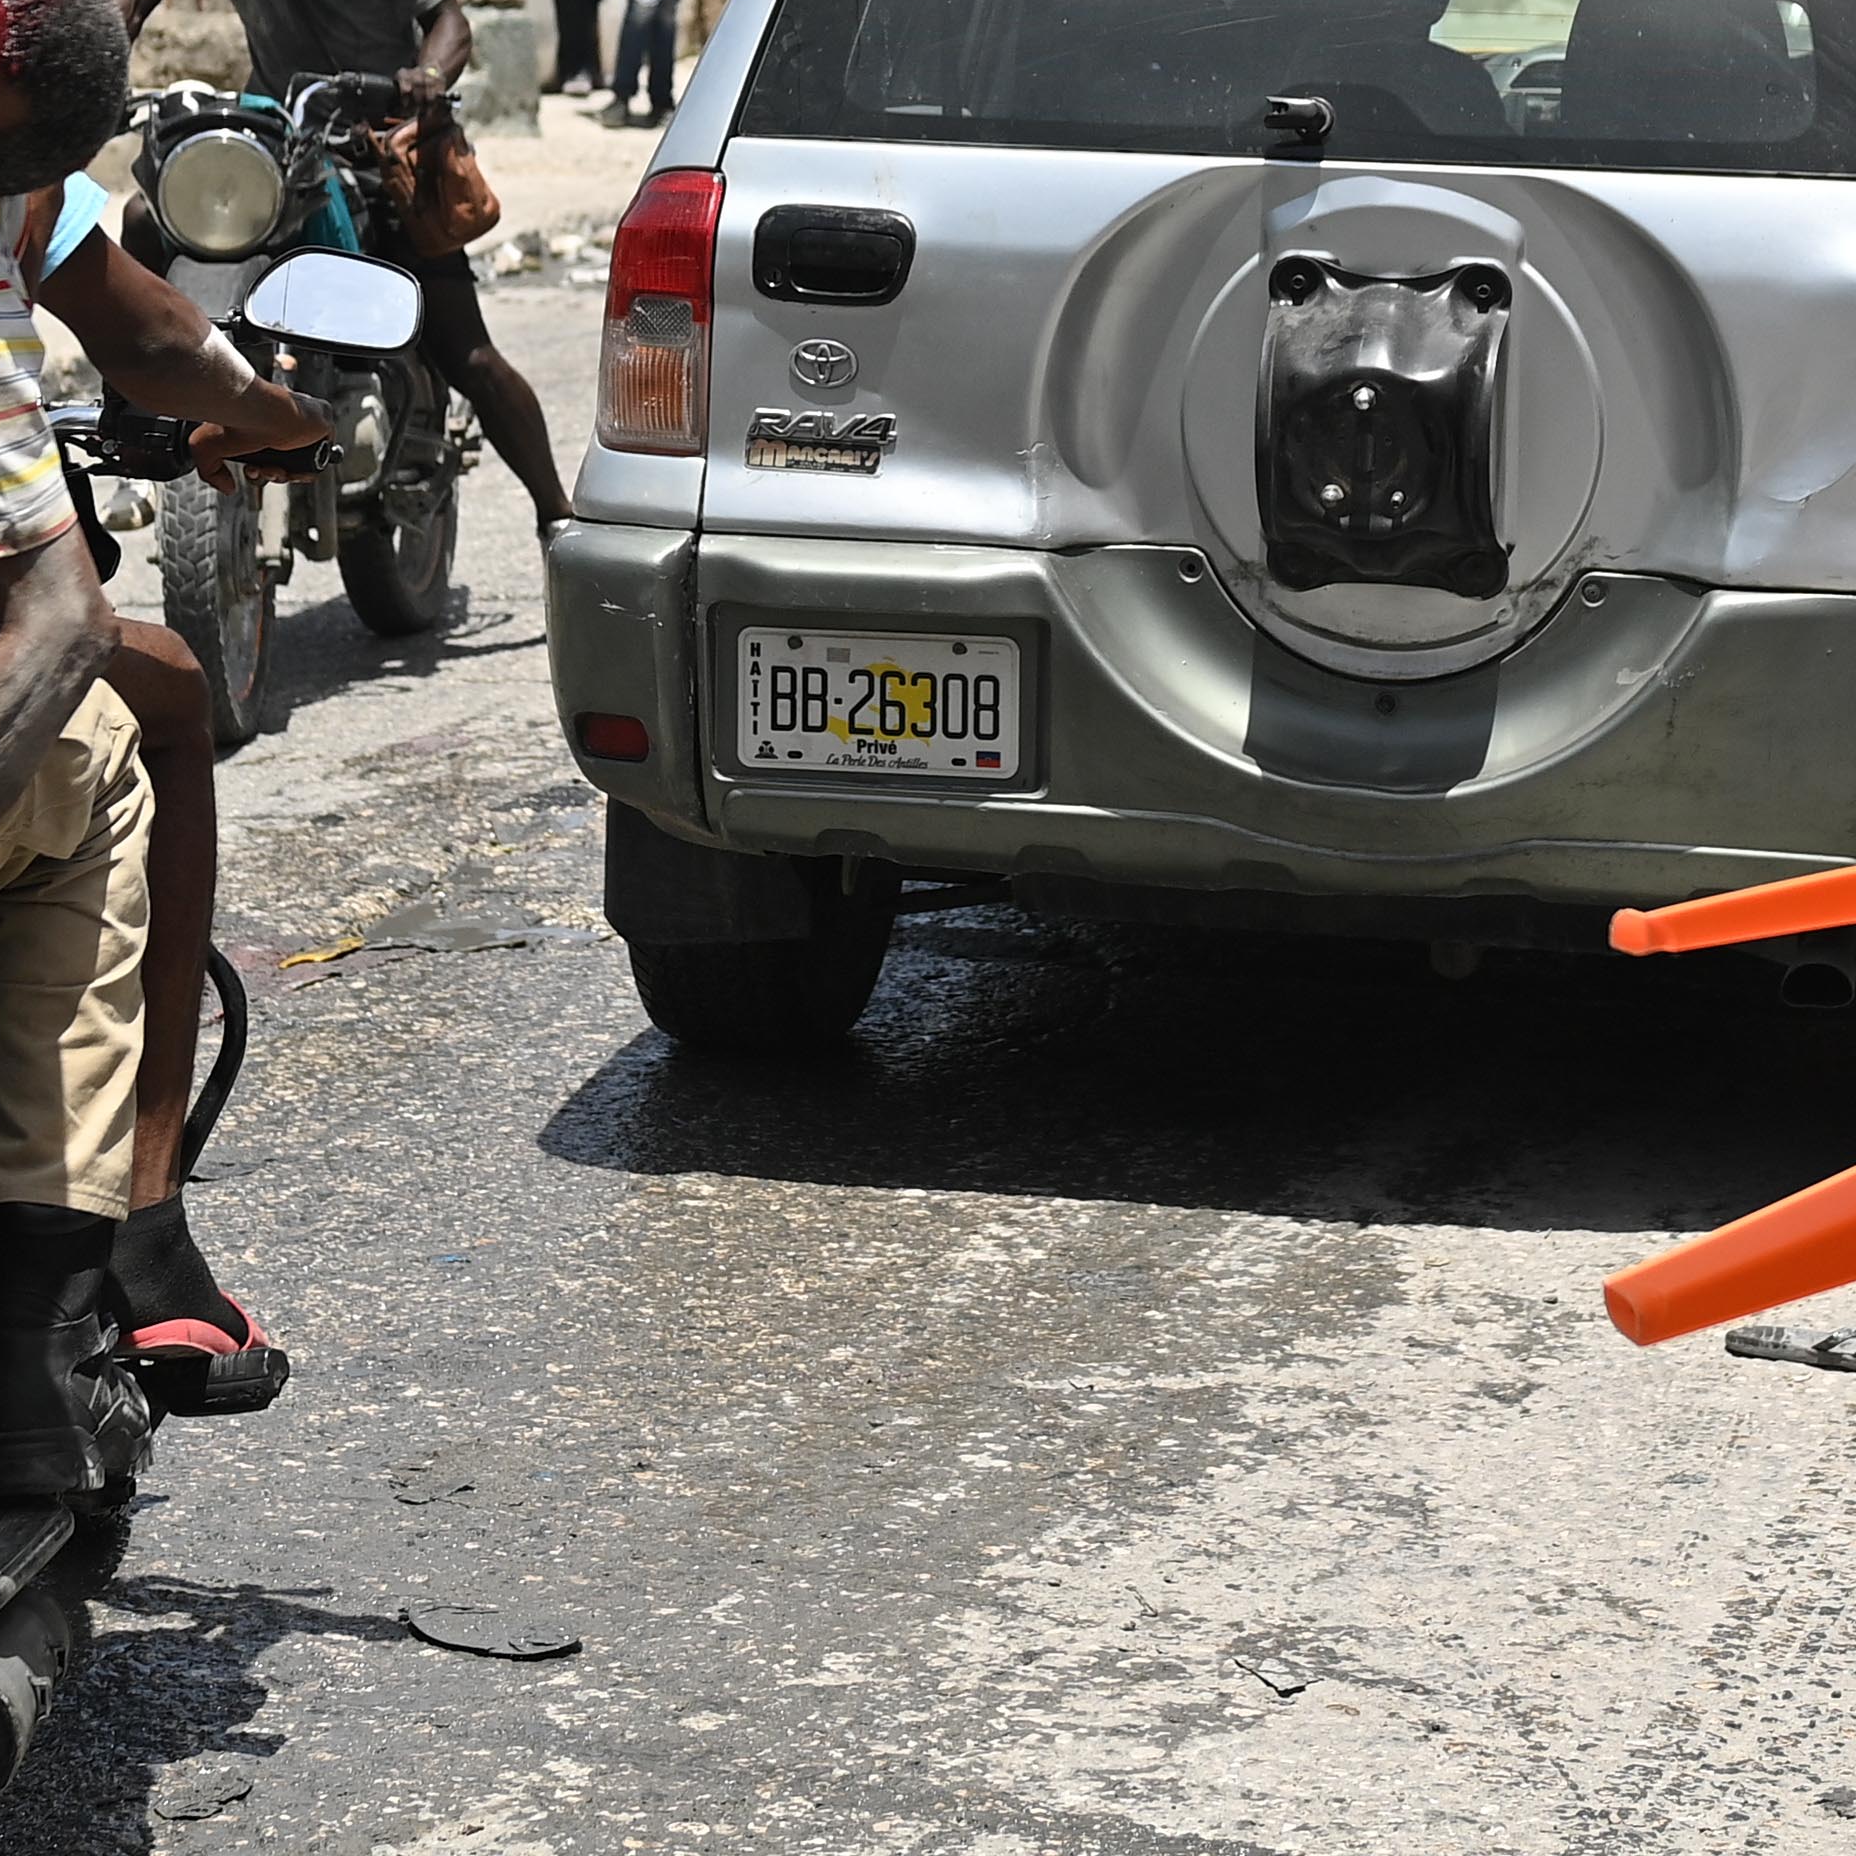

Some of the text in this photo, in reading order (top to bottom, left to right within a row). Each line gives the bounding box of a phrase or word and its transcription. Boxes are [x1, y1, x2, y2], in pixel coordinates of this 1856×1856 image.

[747, 406, 898, 446] RAV4
[770, 664, 1001, 741] BB-26308
[856, 738, 898, 755] Privé
[825, 753, 929, 770] La Perle Des Antilles
